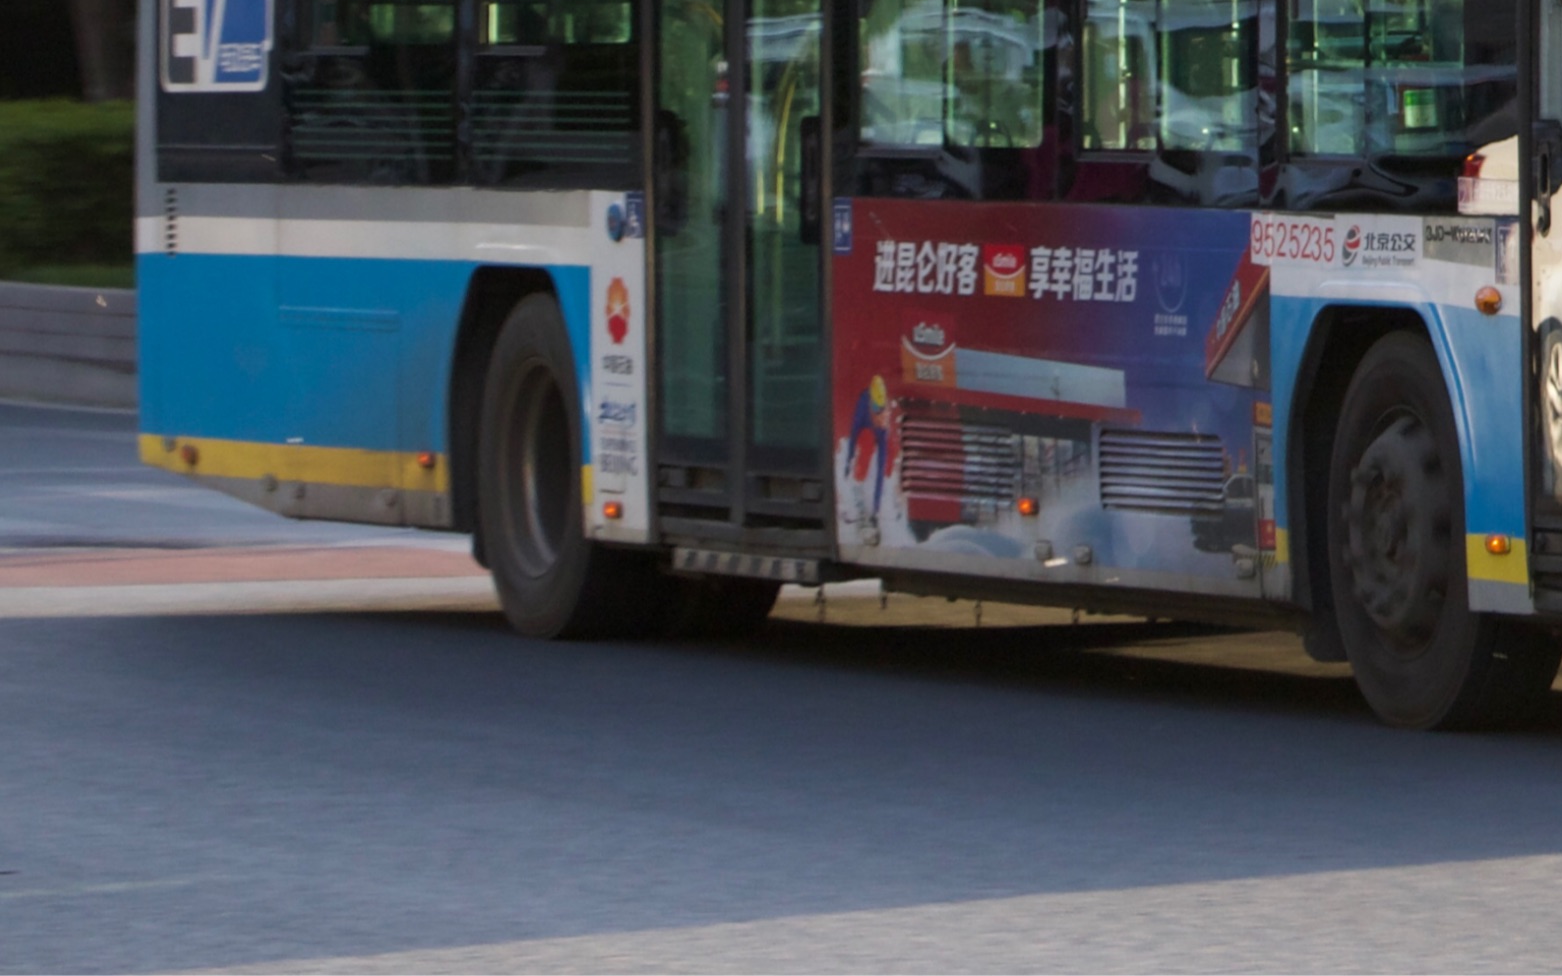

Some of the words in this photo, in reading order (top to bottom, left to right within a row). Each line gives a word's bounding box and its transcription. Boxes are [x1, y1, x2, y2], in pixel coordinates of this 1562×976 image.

[1251, 220, 1336, 263] 9525235
[1363, 231, 1417, 253] 北京公交
[873, 240, 980, 296] 进昆仑好客
[1029, 245, 1140, 303] 享幸福生活
